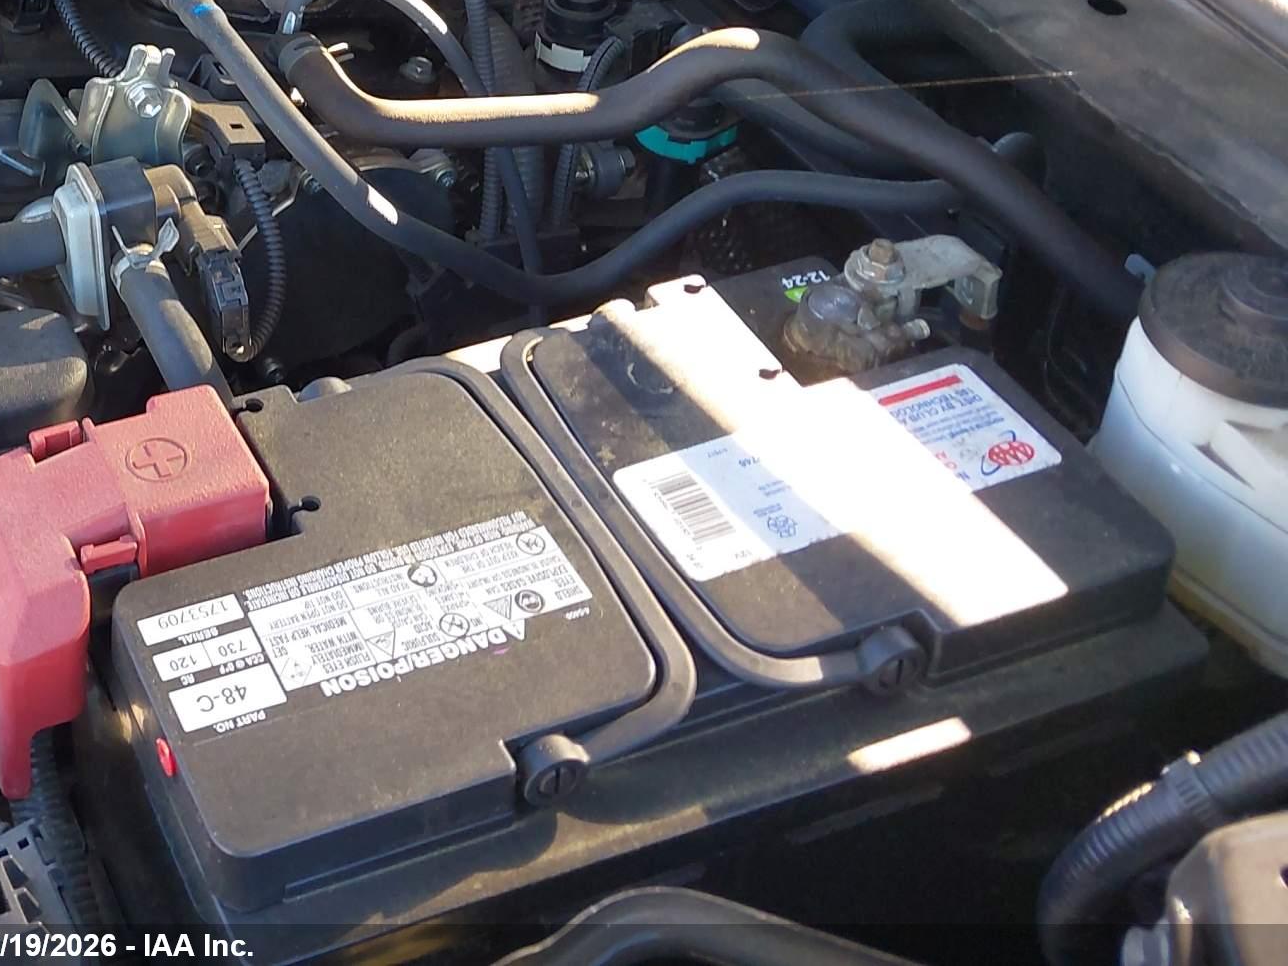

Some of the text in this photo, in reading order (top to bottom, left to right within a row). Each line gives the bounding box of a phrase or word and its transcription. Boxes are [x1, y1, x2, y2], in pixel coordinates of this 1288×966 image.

[782, 270, 831, 290] 12-24
[155, 599, 228, 630] 1753709
[289, 627, 311, 640] HELP
[310, 616, 347, 634] MEDICAL
[177, 626, 219, 645] SERIAL
[334, 630, 359, 645] WITH
[216, 639, 247, 657] 730
[271, 645, 288, 658] GET
[310, 641, 366, 665] IMMEDIATELY
[168, 653, 197, 672] 120
[244, 652, 265, 666] CCA
[318, 626, 508, 696] DANGER/POISON
[322, 651, 371, 673] FLUSH EYES
[195, 681, 249, 714] 48-C
[212, 708, 266, 734] PART NO.
